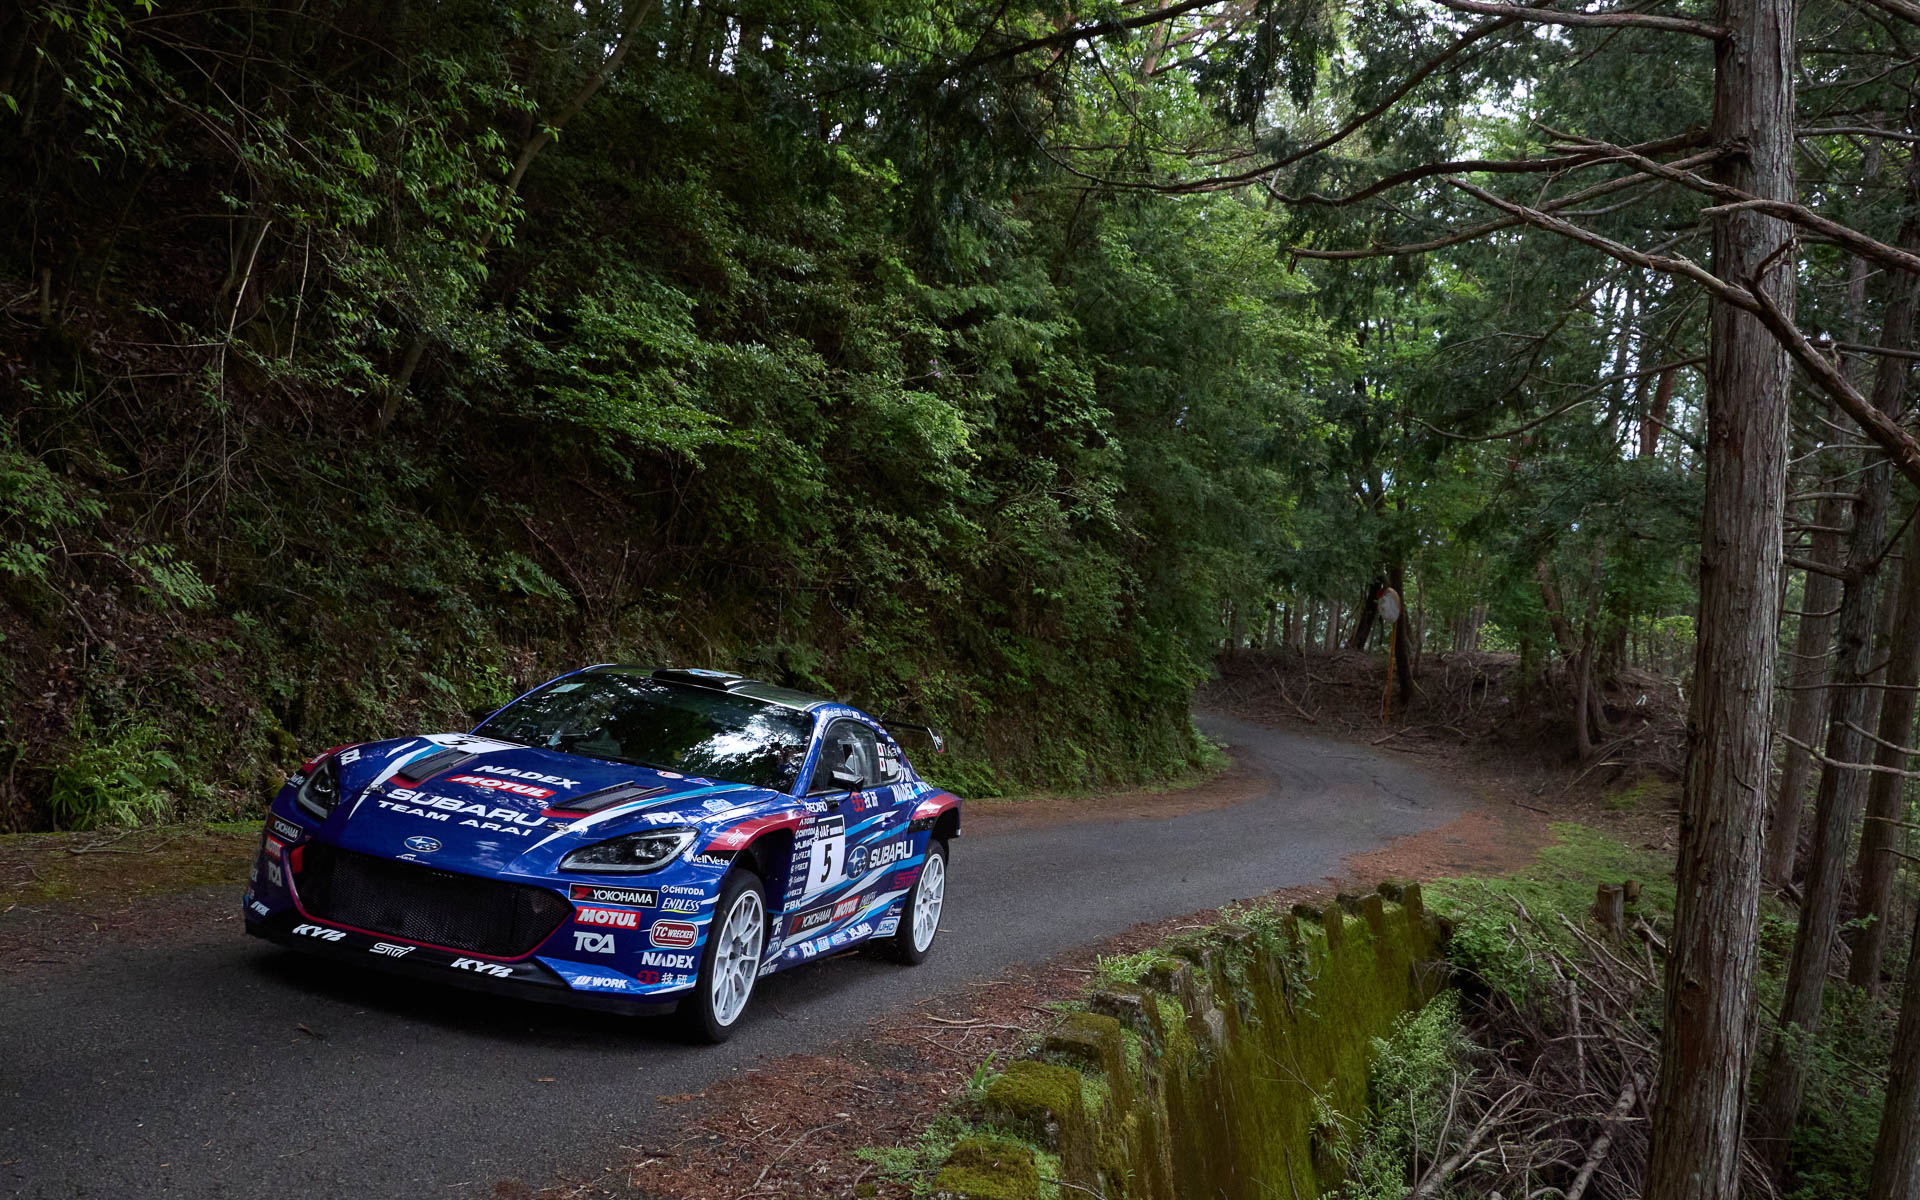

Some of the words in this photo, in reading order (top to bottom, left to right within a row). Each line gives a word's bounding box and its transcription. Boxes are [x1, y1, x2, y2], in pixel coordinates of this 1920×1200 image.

[473, 765, 580, 789] NADEX
[451, 776, 547, 798] MOTUL
[386, 788, 549, 827] SUBARU
[804, 801, 828, 813] RECARO
[378, 801, 451, 822] TEAM
[458, 819, 533, 837] ARAI
[821, 843, 833, 883] 5
[869, 839, 914, 869] SUBARU
[592, 889, 653, 904] YOKOHAMA
[669, 886, 705, 896] CHIYODA
[661, 897, 700, 911] ENDLESS
[783, 898, 801, 912] FBK
[833, 898, 858, 919] MOTUL
[577, 908, 637, 927] MOTUL
[801, 908, 832, 929] YOKOHAMA
[292, 924, 347, 942] KYB
[655, 926, 668, 937] TC
[667, 928, 695, 939] WRECKER
[450, 957, 514, 978] KYB
[641, 952, 695, 969] NADEX
[591, 978, 628, 989] WORK
[661, 972, 689, 985] 技研
